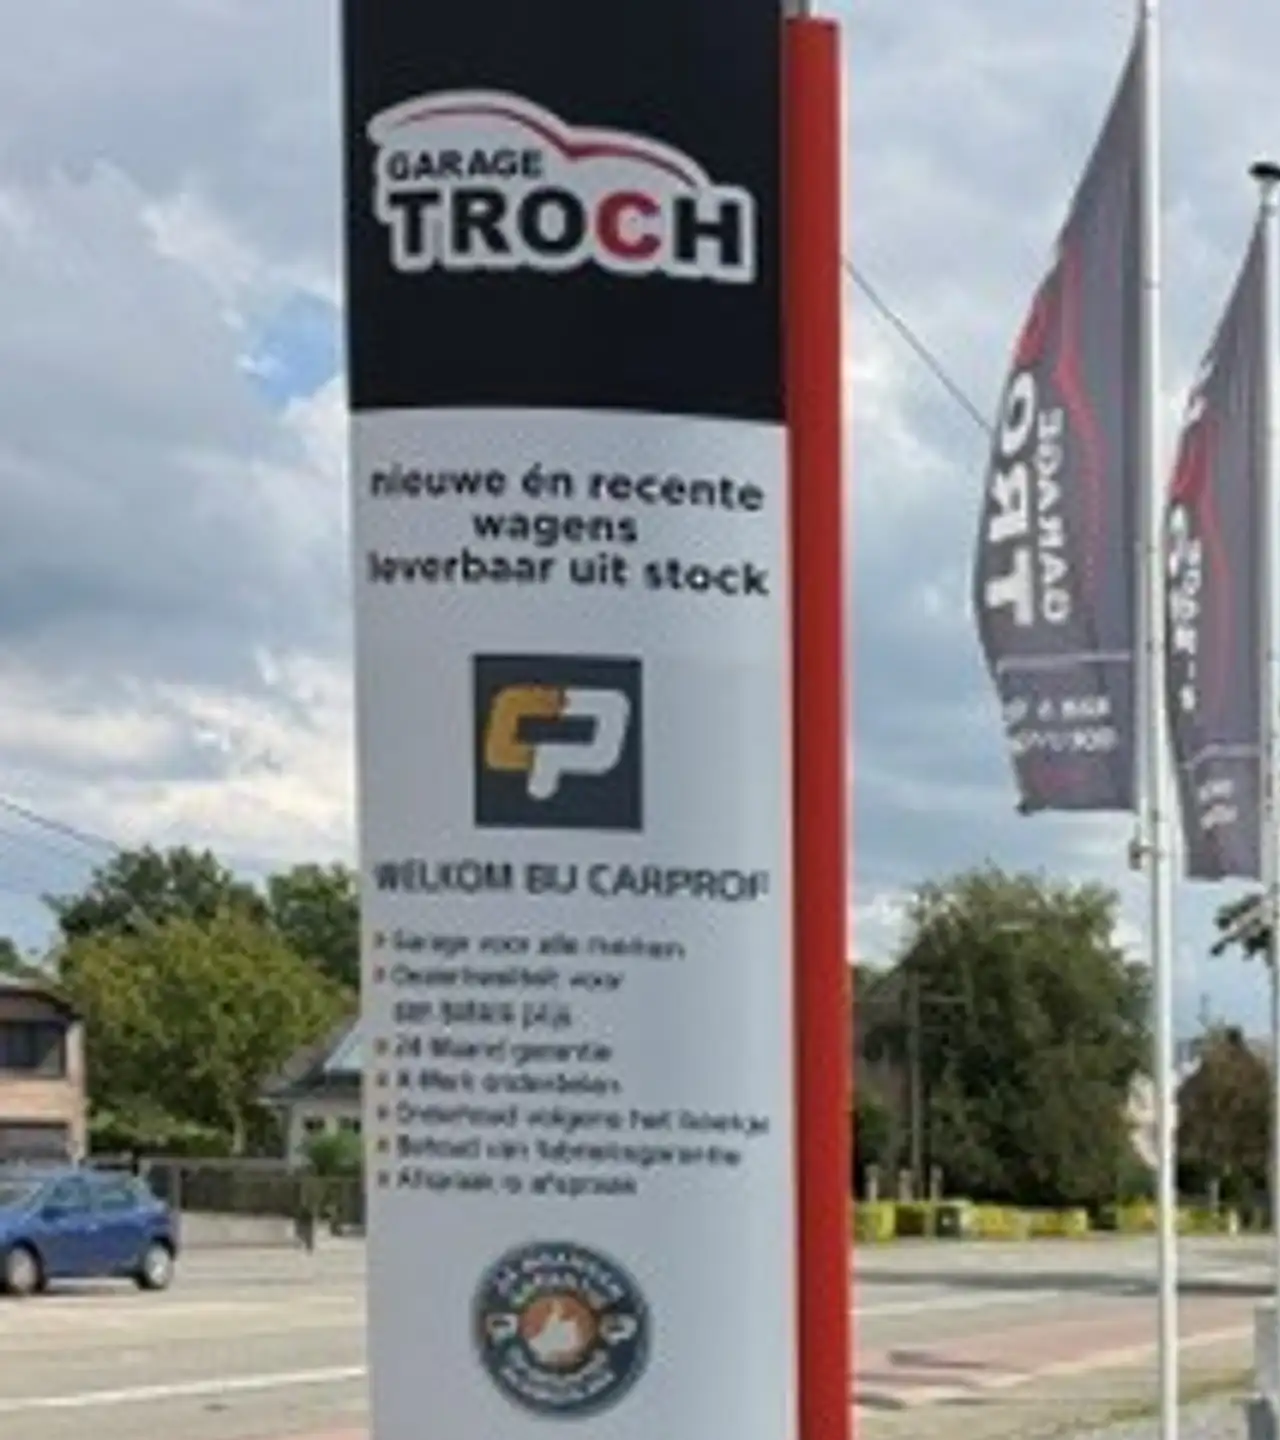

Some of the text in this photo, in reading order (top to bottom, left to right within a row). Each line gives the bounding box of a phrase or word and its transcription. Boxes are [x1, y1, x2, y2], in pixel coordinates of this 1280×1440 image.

[386, 149, 544, 182] GARAGE
[386, 187, 742, 266] TROCH
[369, 462, 765, 511] nieuwe én recente
[472, 512, 638, 544] wagens
[369, 551, 770, 596] leverbaar uit stock
[373, 861, 512, 895] WELKOM
[587, 866, 769, 902] CARPROF
